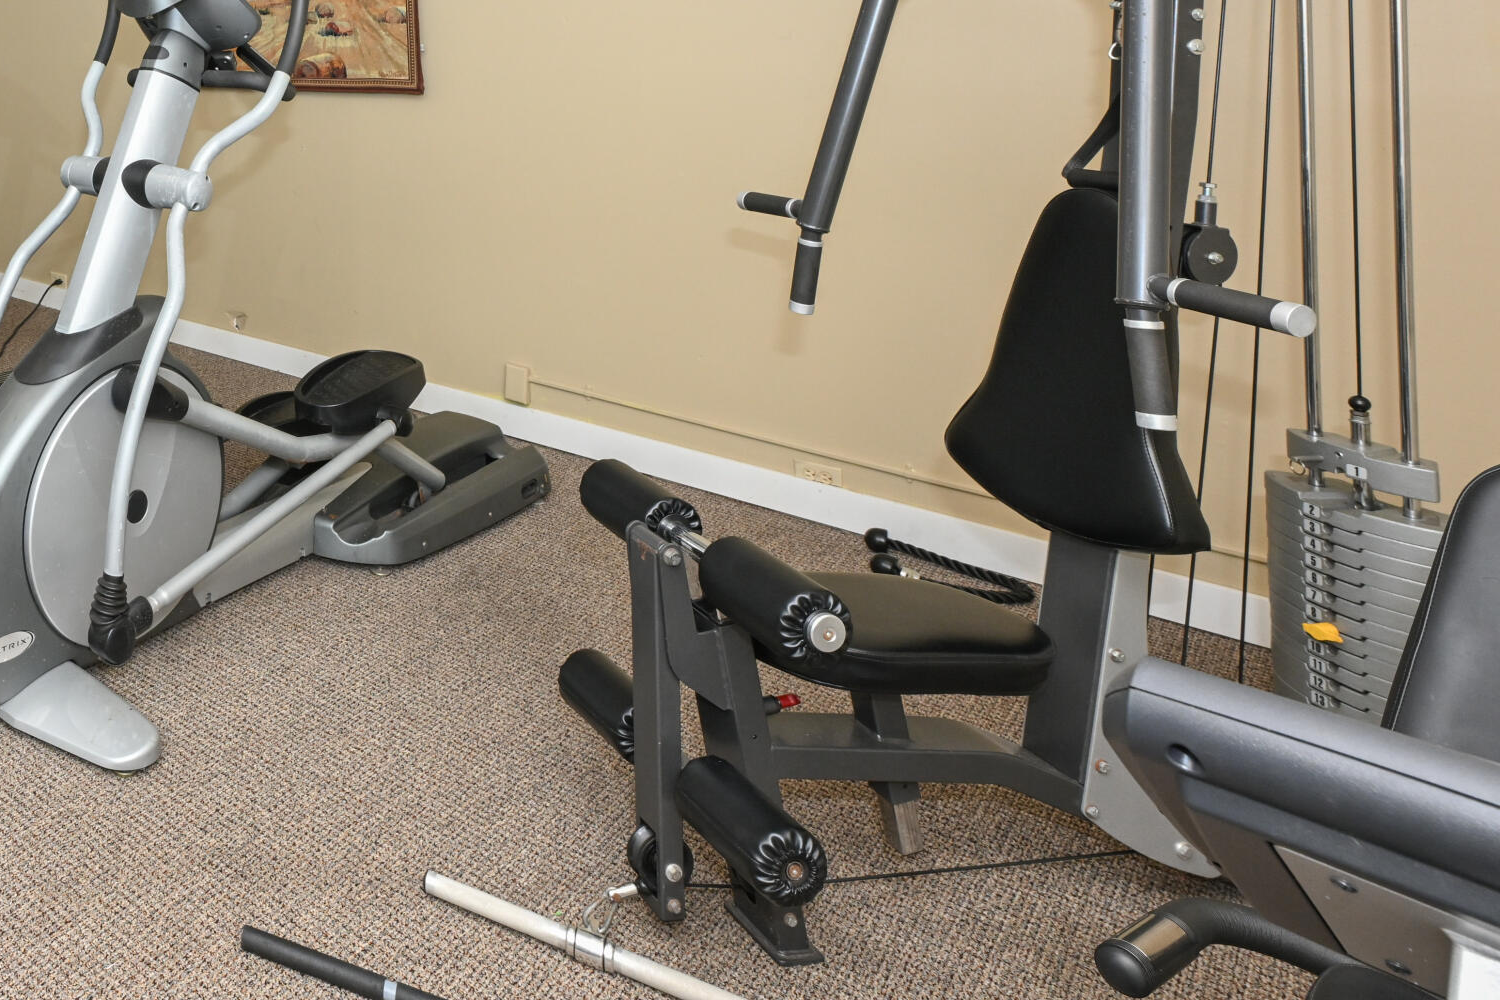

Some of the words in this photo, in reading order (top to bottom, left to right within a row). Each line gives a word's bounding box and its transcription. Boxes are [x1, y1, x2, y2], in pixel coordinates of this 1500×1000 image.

[1313, 658, 1322, 670] 11
[1313, 675, 1324, 688] 12
[1315, 693, 1325, 706] 13
